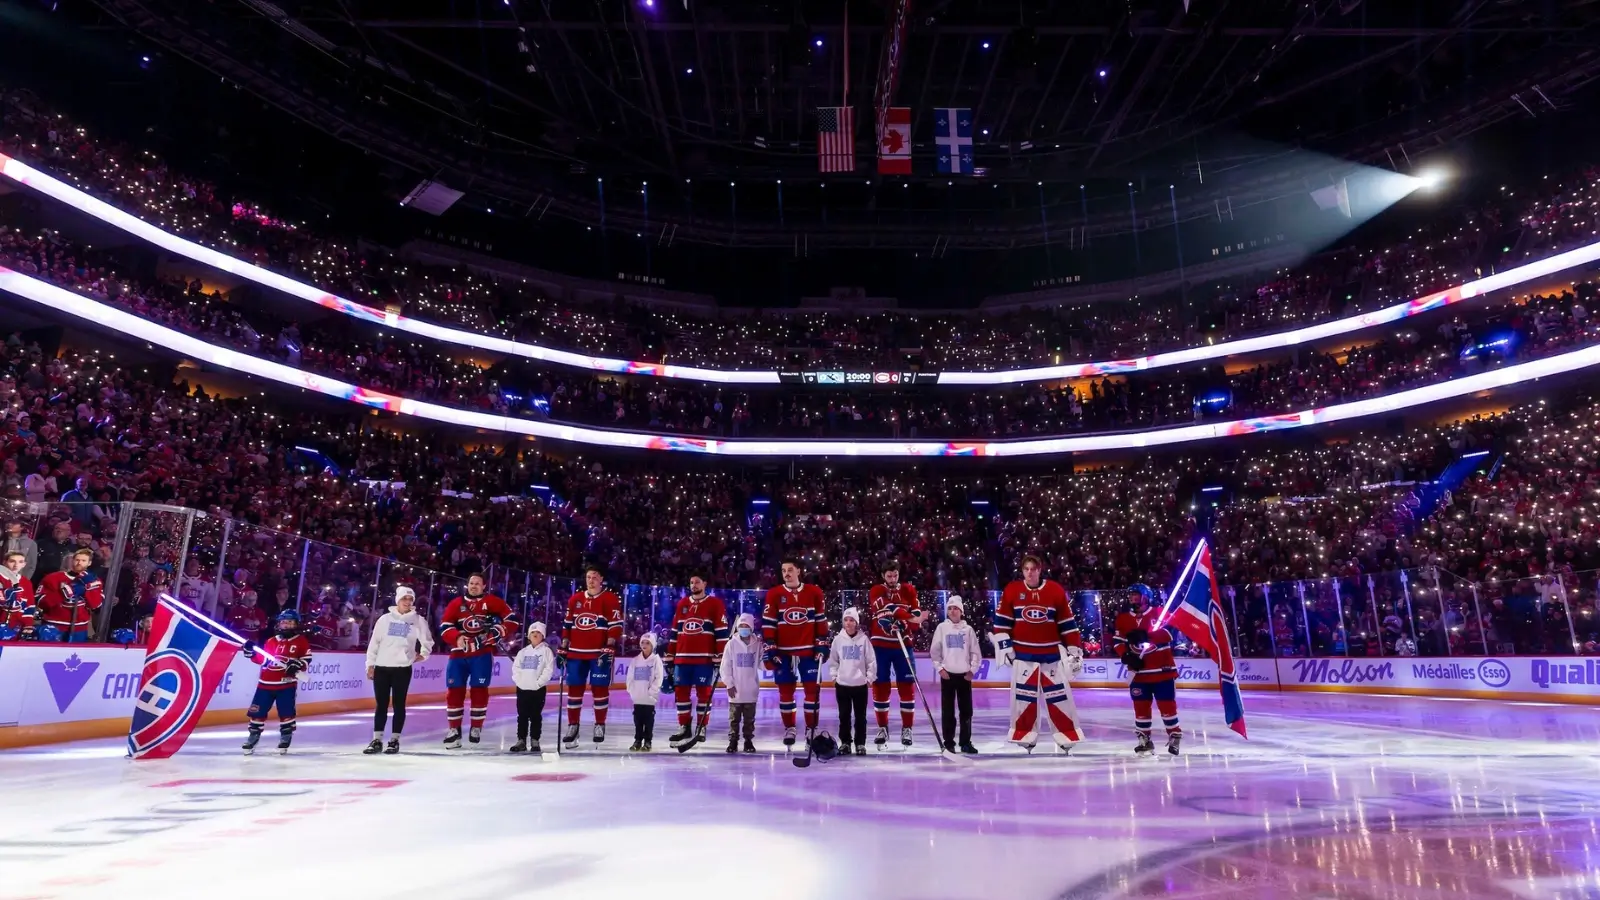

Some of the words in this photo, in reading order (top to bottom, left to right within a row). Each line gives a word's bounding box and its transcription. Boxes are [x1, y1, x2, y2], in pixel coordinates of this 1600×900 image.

[481, 602, 488, 610] A
[289, 645, 297, 653] C
[308, 663, 321, 674] out
[1083, 664, 1106, 673] ise
[1114, 662, 1128, 679] Ti
[1177, 664, 1211, 680] tons
[1292, 659, 1394, 683] Molson
[1412, 664, 1476, 680] Médailles
[1482, 666, 1506, 679] Esso
[325, 677, 362, 690] connexion
